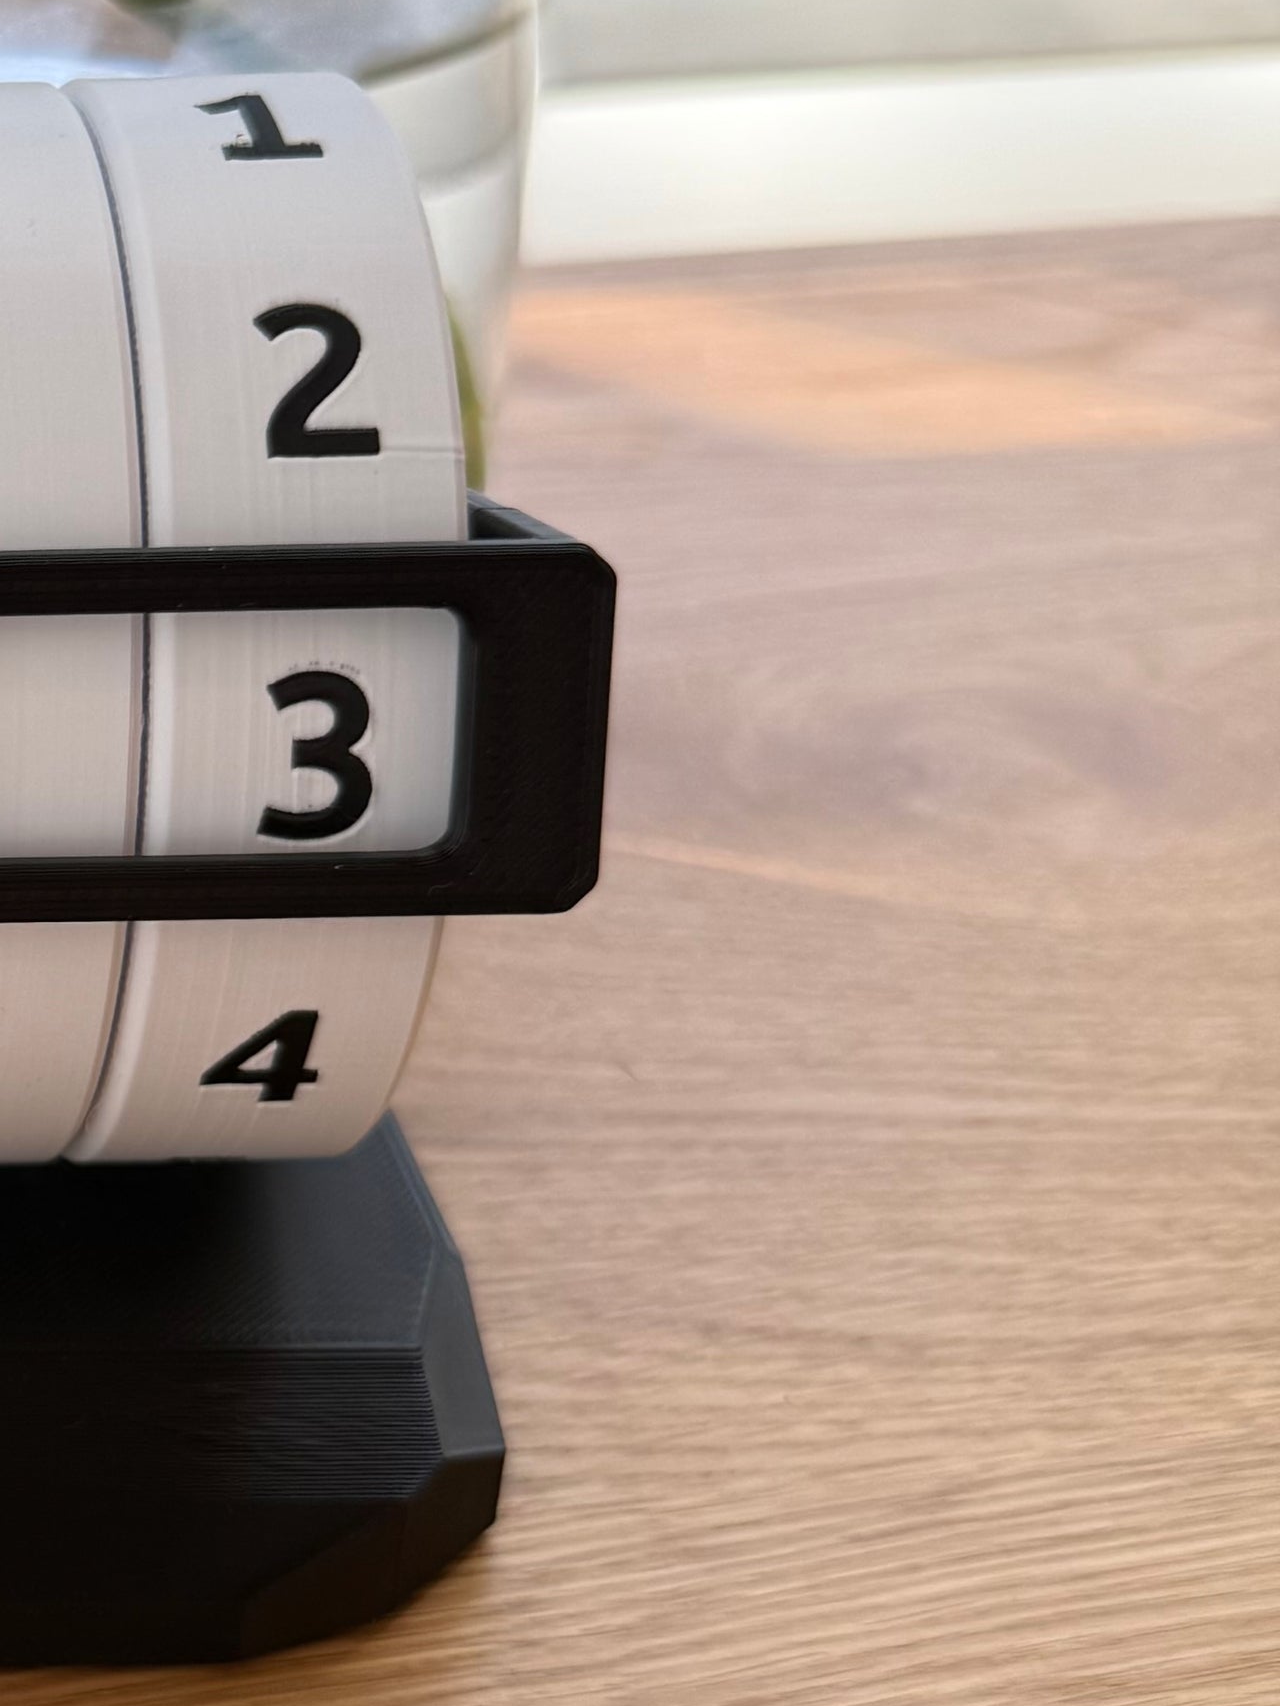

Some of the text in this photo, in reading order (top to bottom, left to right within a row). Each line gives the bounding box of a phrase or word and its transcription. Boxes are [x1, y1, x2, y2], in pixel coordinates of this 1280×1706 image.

[193, 92, 324, 161] 1
[253, 303, 380, 458] 2
[256, 670, 373, 840] 3
[199, 1009, 319, 1102] 4
